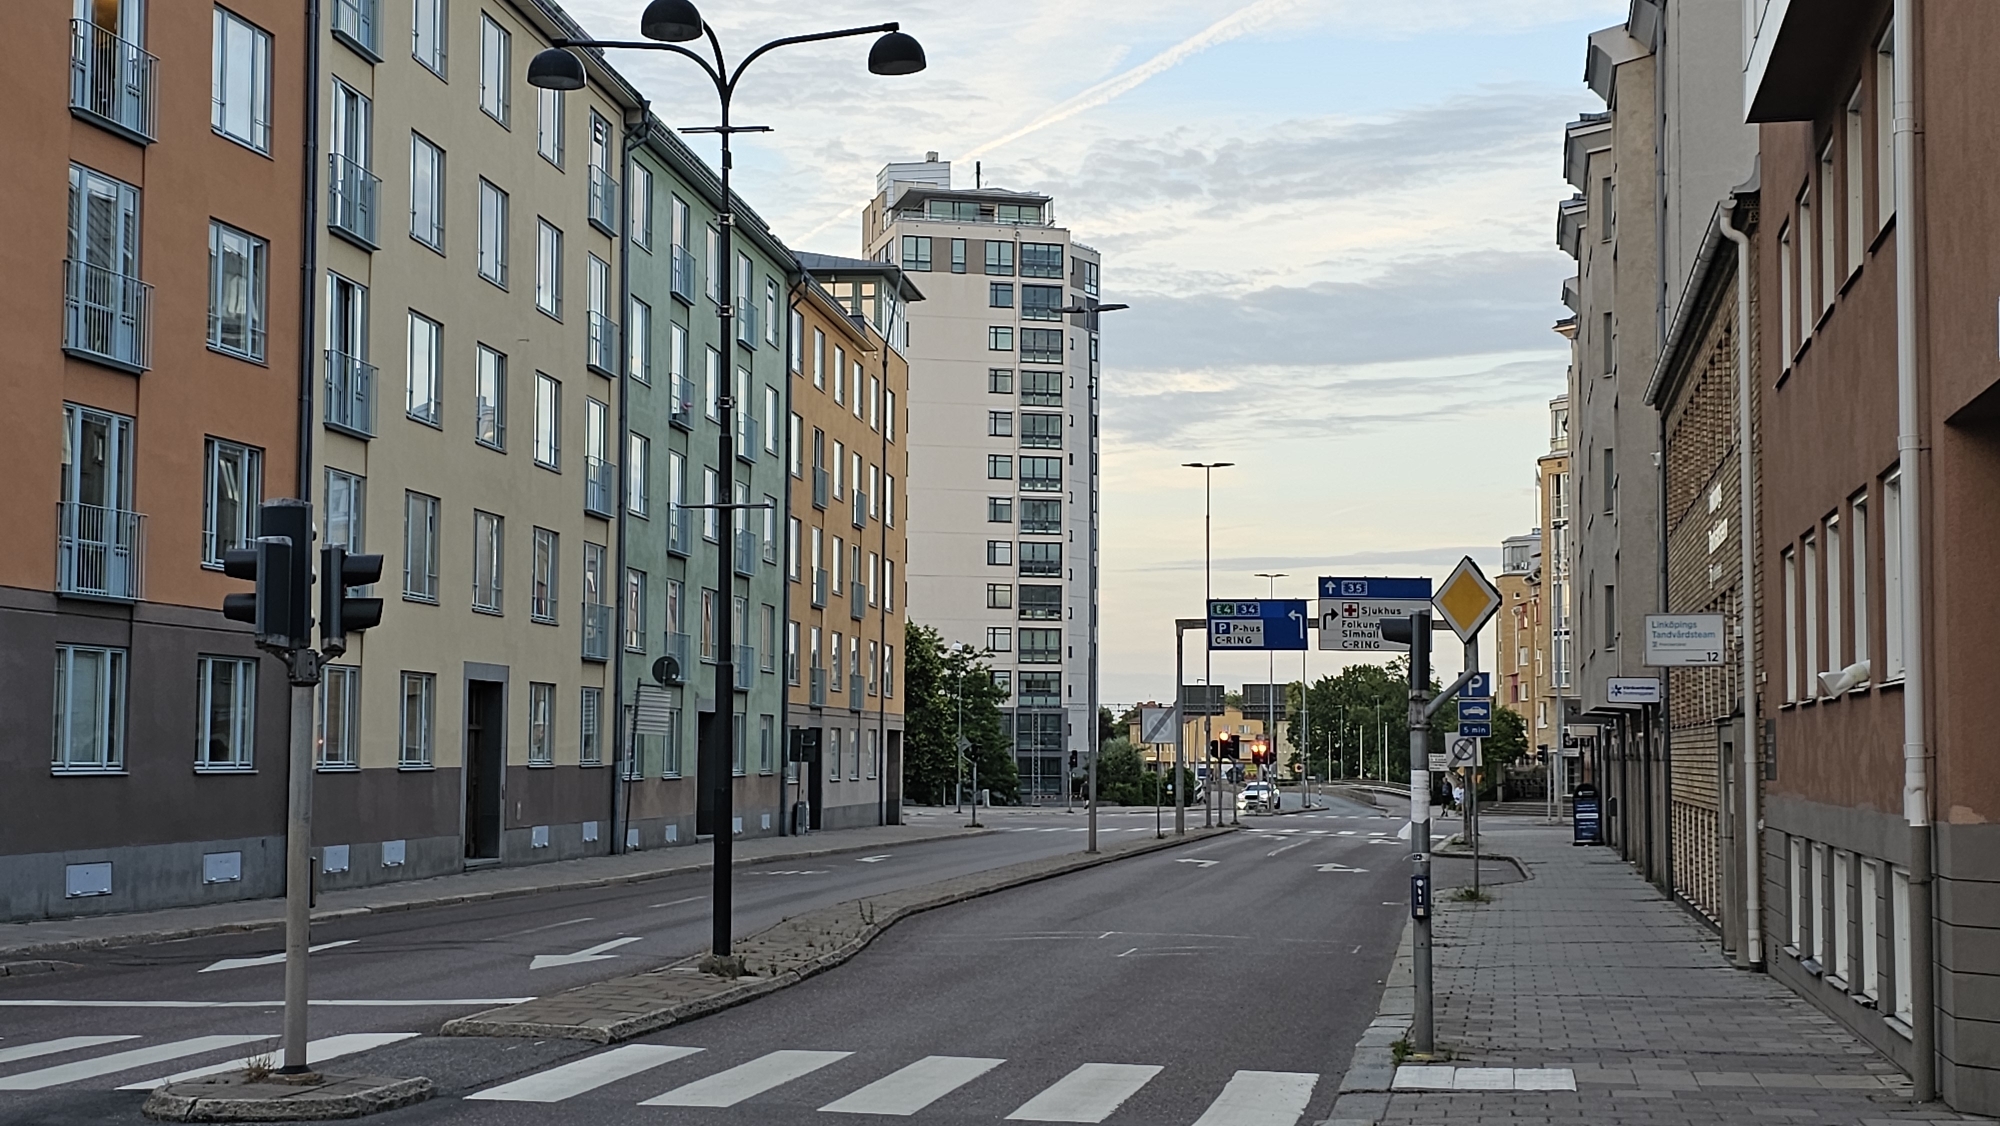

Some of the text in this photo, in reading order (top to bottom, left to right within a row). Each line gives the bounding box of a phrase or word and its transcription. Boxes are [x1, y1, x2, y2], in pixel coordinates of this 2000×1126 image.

[1348, 584, 1363, 593] 35
[1216, 605, 1255, 614] E4 34
[1361, 606, 1402, 617] Sjukhus
[1233, 624, 1261, 633] P-hus
[1341, 620, 1381, 631] Folkung
[1651, 621, 1698, 630] Linköpings
[1652, 630, 1716, 639] Tandvårdsteam
[1215, 636, 1253, 645] C-RING
[1341, 640, 1380, 649] C-RING
[1706, 651, 1719, 662] 12
[1468, 674, 1483, 696] P
